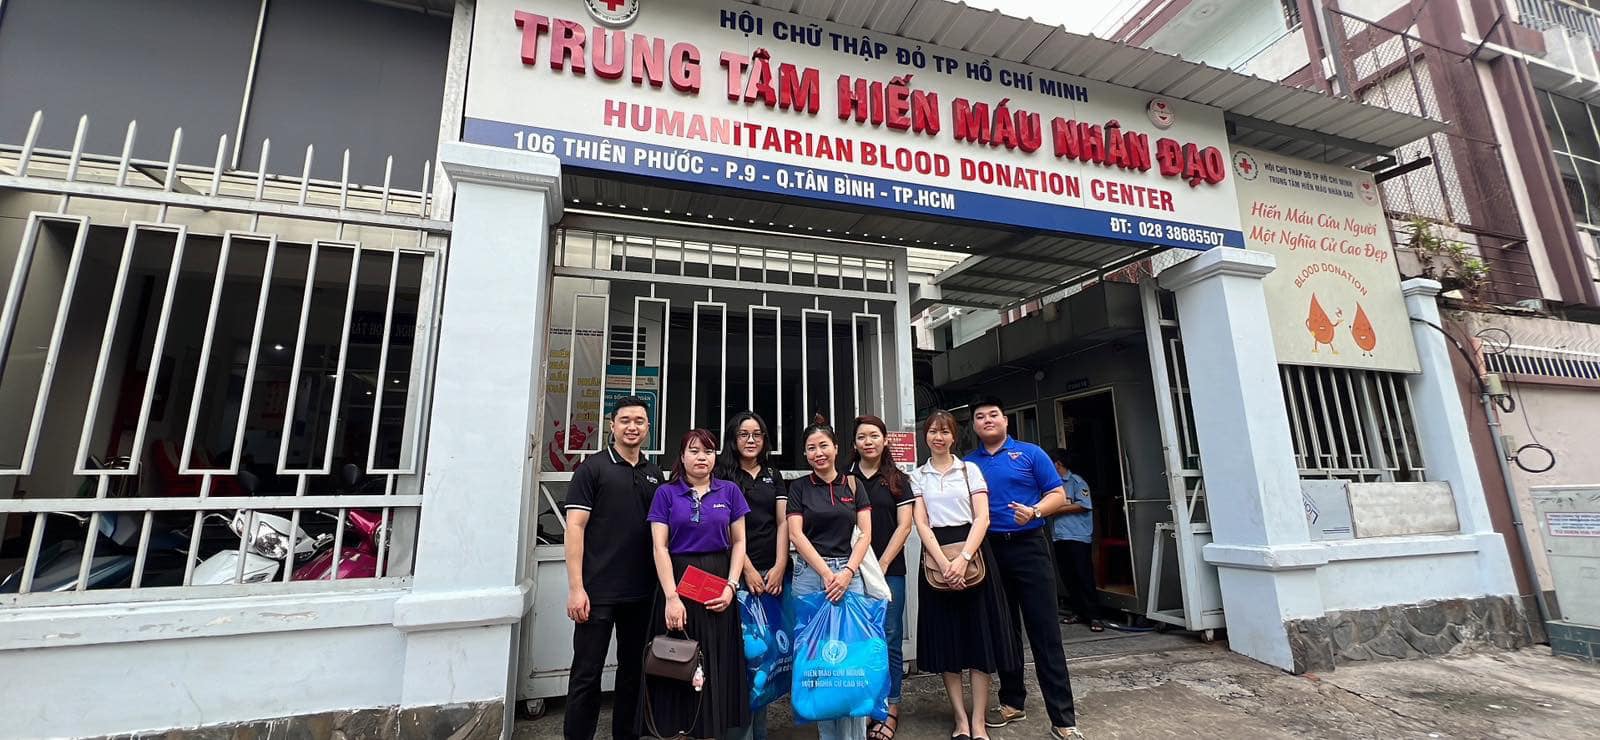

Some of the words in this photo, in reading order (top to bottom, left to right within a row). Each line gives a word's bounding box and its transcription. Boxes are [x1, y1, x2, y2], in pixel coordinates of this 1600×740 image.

[720, 9, 763, 38] HỘI
[773, 21, 823, 47] CHỮ
[829, 32, 888, 62] THẬP
[896, 45, 926, 69] ĐỎ
[932, 54, 958, 75] TP
[965, 59, 993, 83] HỒ
[1000, 69, 1033, 92] CHÍ
[1039, 78, 1089, 102] MINH
[514, 10, 701, 95] TRUNG
[720, 47, 820, 115] TÂM
[837, 74, 940, 136] HIẾN
[952, 98, 1042, 153] MÁU
[1051, 116, 1152, 173] NHÂN
[1156, 137, 1226, 188] ĐẠO
[513, 131, 555, 154] 106
[563, 137, 626, 165] THIÊN
[633, 149, 704, 174] PHƯỚC
[725, 161, 756, 182] P.9
[776, 169, 829, 193] Q.TÂN
[834, 175, 875, 199] BÌNH
[892, 186, 956, 210] TP.HCM
[603, 99, 853, 163] HUMANITARIAN
[860, 140, 951, 178] BLOOD
[960, 157, 1081, 199] DONATION
[1090, 178, 1176, 212] CENTER
[1110, 217, 1132, 234] ĐT:
[1139, 221, 1163, 238] 028
[1166, 225, 1224, 247] 38685507
[1249, 225, 1277, 245] Một
[1279, 229, 1316, 251] Nghĩa
[1320, 236, 1338, 253] Cử
[1340, 239, 1361, 256] Cao
[1364, 243, 1388, 263] Đẹp
[1251, 201, 1281, 220] Hiến
[1285, 207, 1313, 226] Máu
[1318, 213, 1340, 230] Cứu
[1343, 217, 1377, 238] Người
[1294, 263, 1320, 289] BLOOD
[1321, 262, 1368, 297] DONATION
